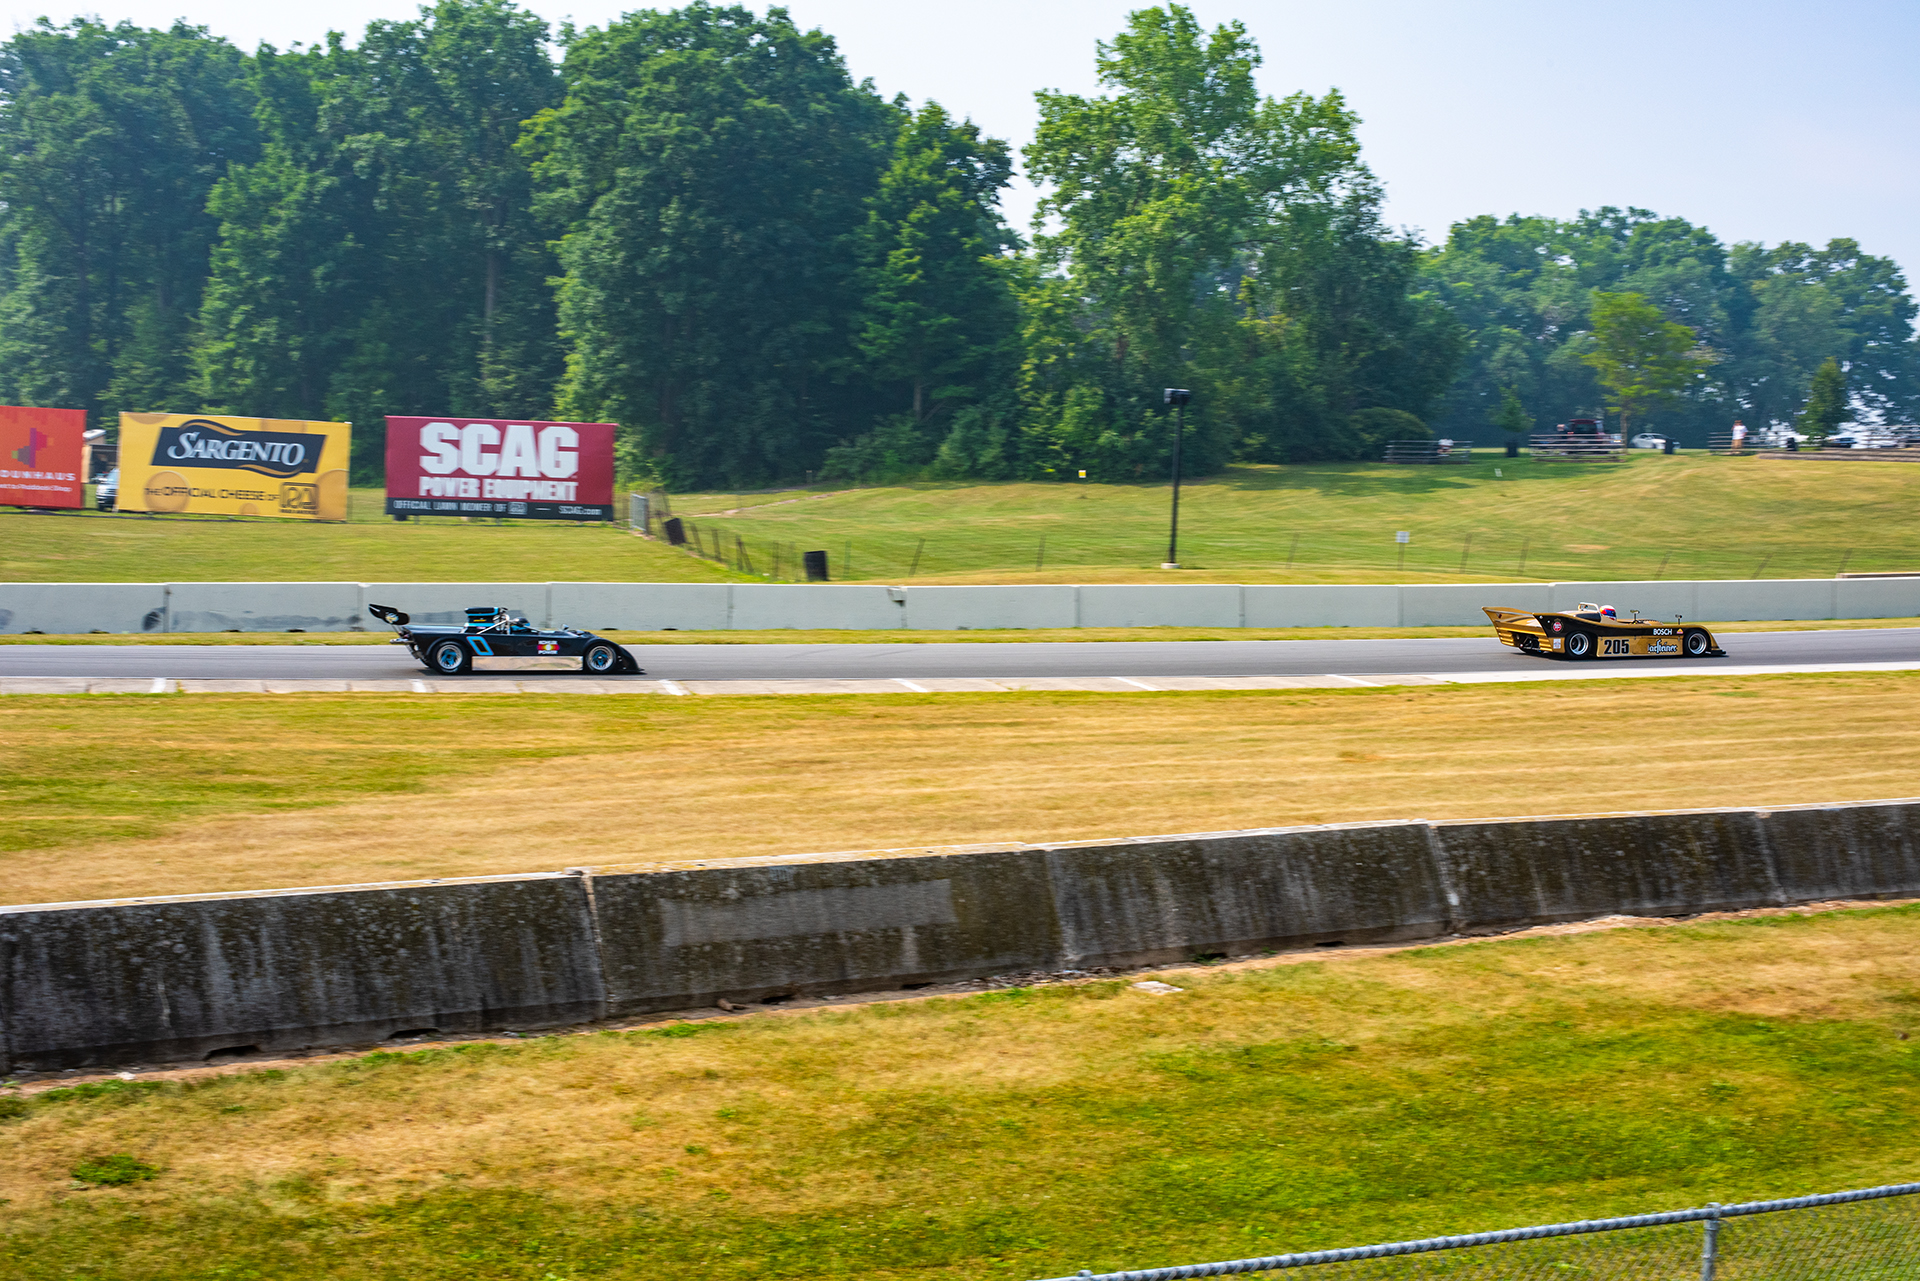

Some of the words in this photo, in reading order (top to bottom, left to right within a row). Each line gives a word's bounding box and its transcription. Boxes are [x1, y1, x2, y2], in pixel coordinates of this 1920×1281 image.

[167, 431, 306, 466] SARGENTO
[419, 422, 579, 479] SCAG
[161, 486, 216, 499] OFFICIAL
[218, 489, 266, 501] CHEESE
[419, 476, 480, 498] POWER
[482, 478, 579, 501] EQUIPMENT
[393, 500, 432, 510] OFFICIAL
[1653, 628, 1672, 636] BOSCH
[1604, 639, 1630, 655] 205
